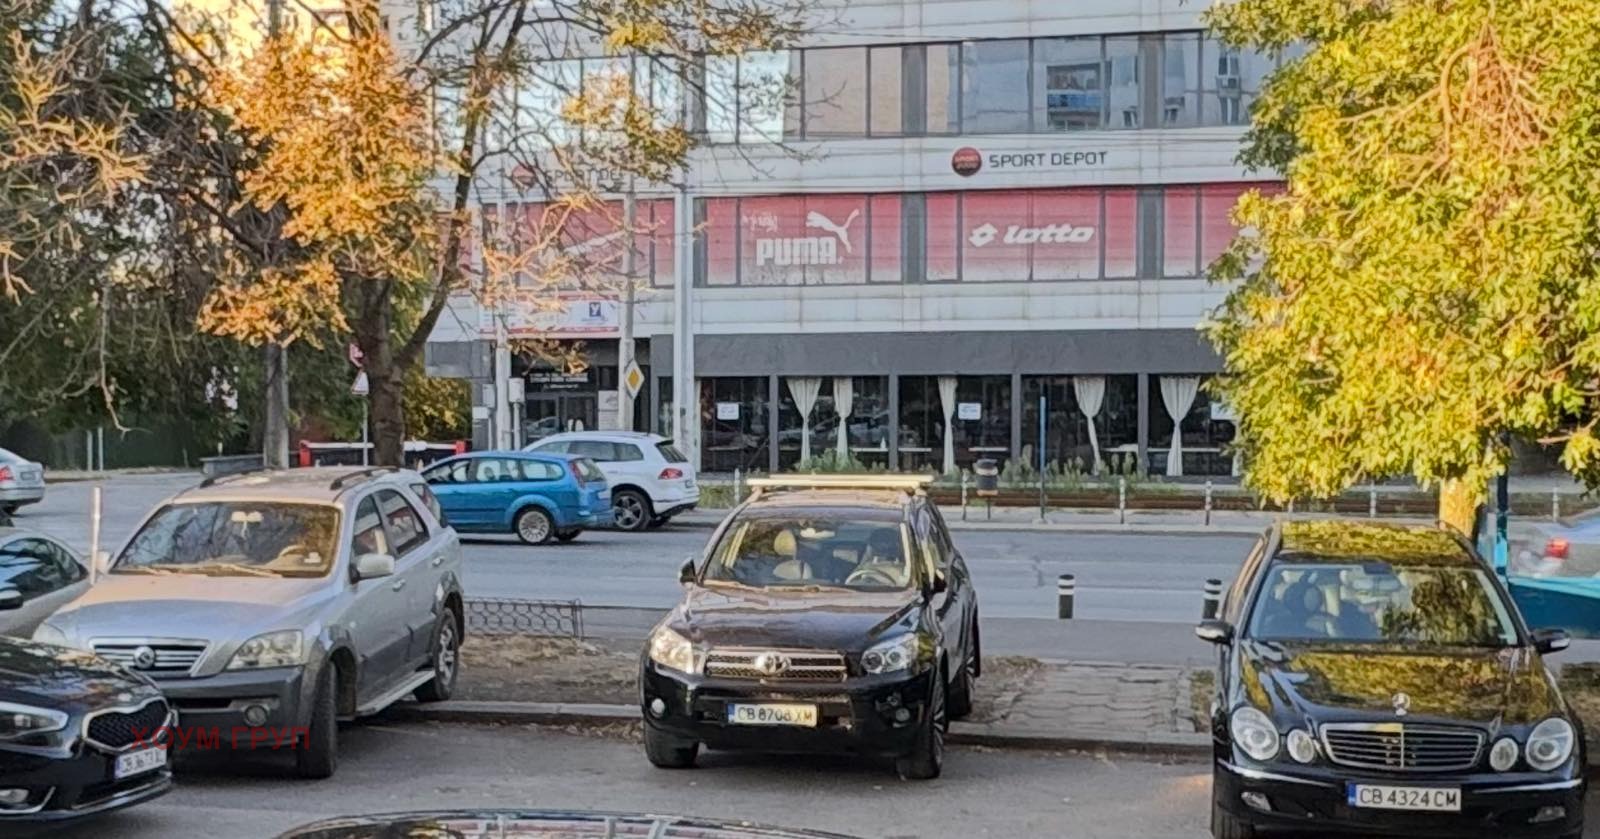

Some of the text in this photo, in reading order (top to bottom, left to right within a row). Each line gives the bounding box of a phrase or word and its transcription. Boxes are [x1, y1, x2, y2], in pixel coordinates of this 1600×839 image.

[989, 151, 1107, 168] SPORT DEPOT
[756, 236, 837, 266] PUMA
[1387, 789, 1430, 807] 4324
